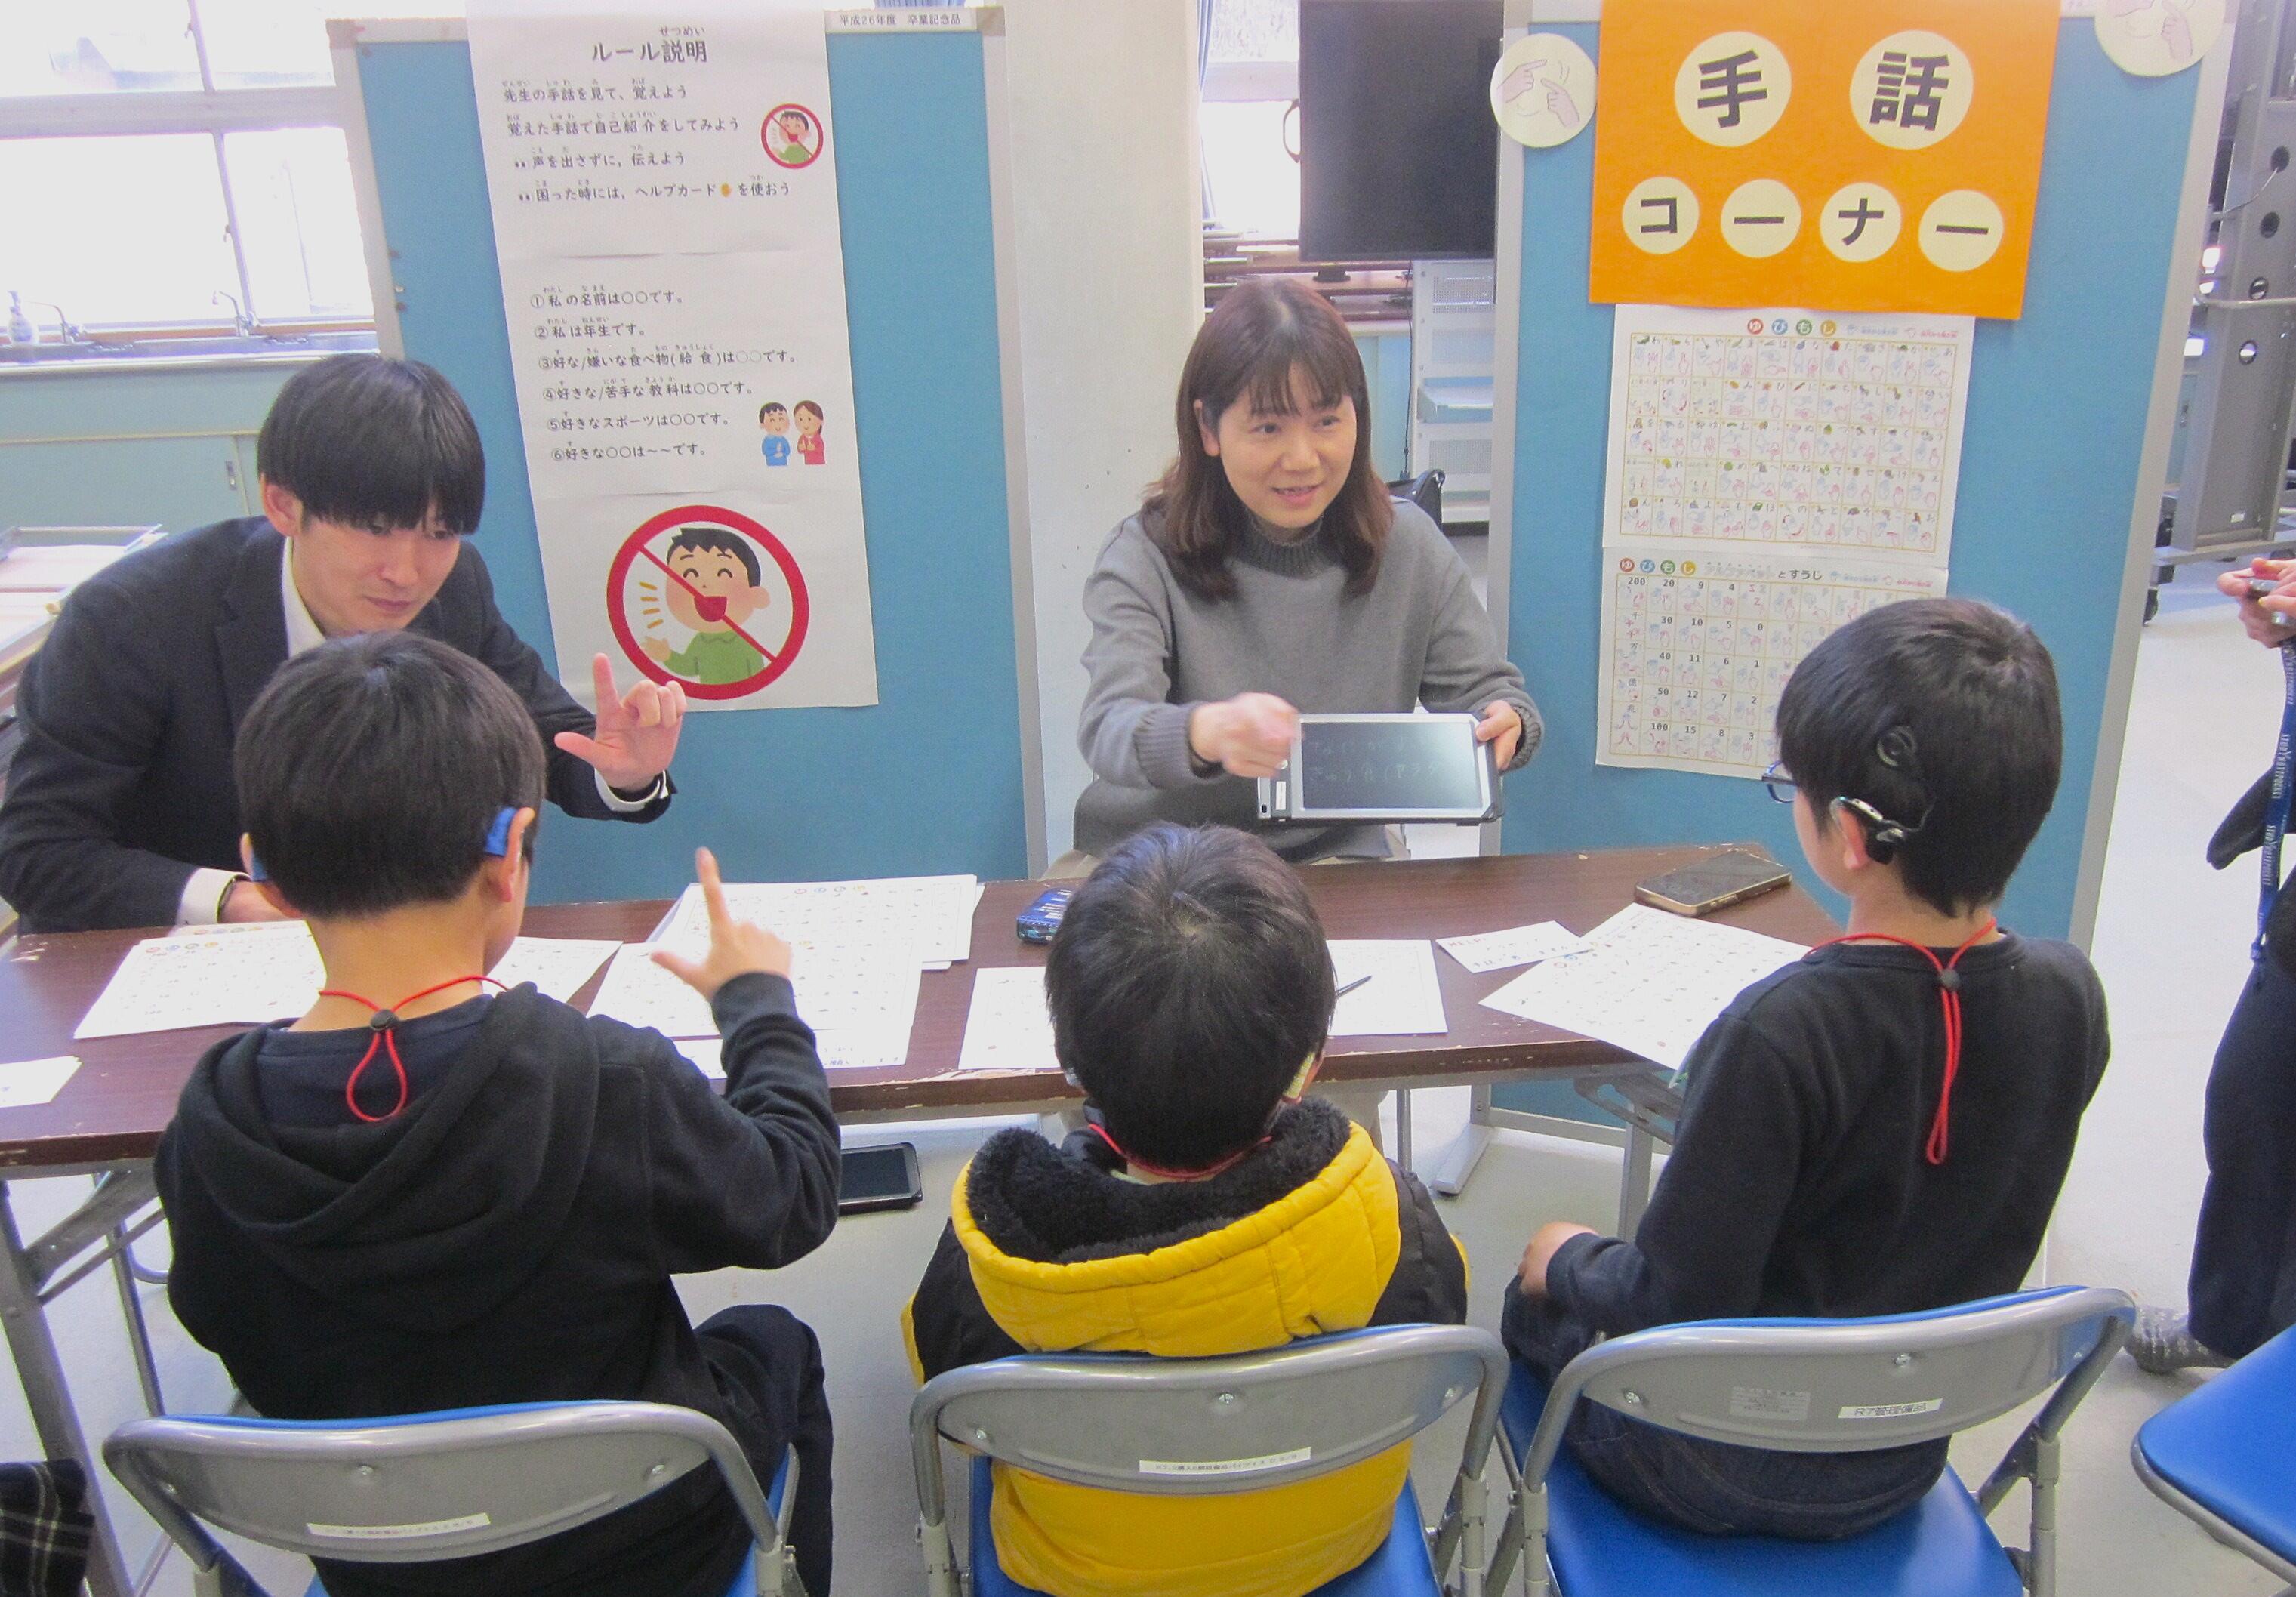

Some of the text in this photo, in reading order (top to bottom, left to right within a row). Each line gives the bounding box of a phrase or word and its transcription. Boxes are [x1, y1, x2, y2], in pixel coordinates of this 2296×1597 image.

[840, 13, 961, 26] 平成26年度 卒業記念品
[660, 26, 705, 36] せつめい
[592, 39, 707, 63] ルール説明
[504, 85, 687, 103] 先生の手話を見て、覚えよう
[1697, 48, 1950, 131] 手話
[507, 116, 741, 137] 覚えた手話で自己紹介をしてみよう
[1640, 196, 1989, 246] コーナー
[1749, 319, 1835, 335] ゆびもじ
[1622, 560, 1693, 575] ゆびもじ
[1777, 569, 1823, 581] とすうじ
[1628, 577, 1646, 586] 200
[1663, 579, 1675, 587] 20
[1661, 616, 1673, 624] 30
[1691, 618, 1703, 627] 10
[1659, 652, 1671, 661] 40
[1689, 655, 1701, 663] 11
[1687, 690, 1699, 698] 12
[1650, 723, 1669, 731] 100
[1684, 726, 1697, 734] 15
